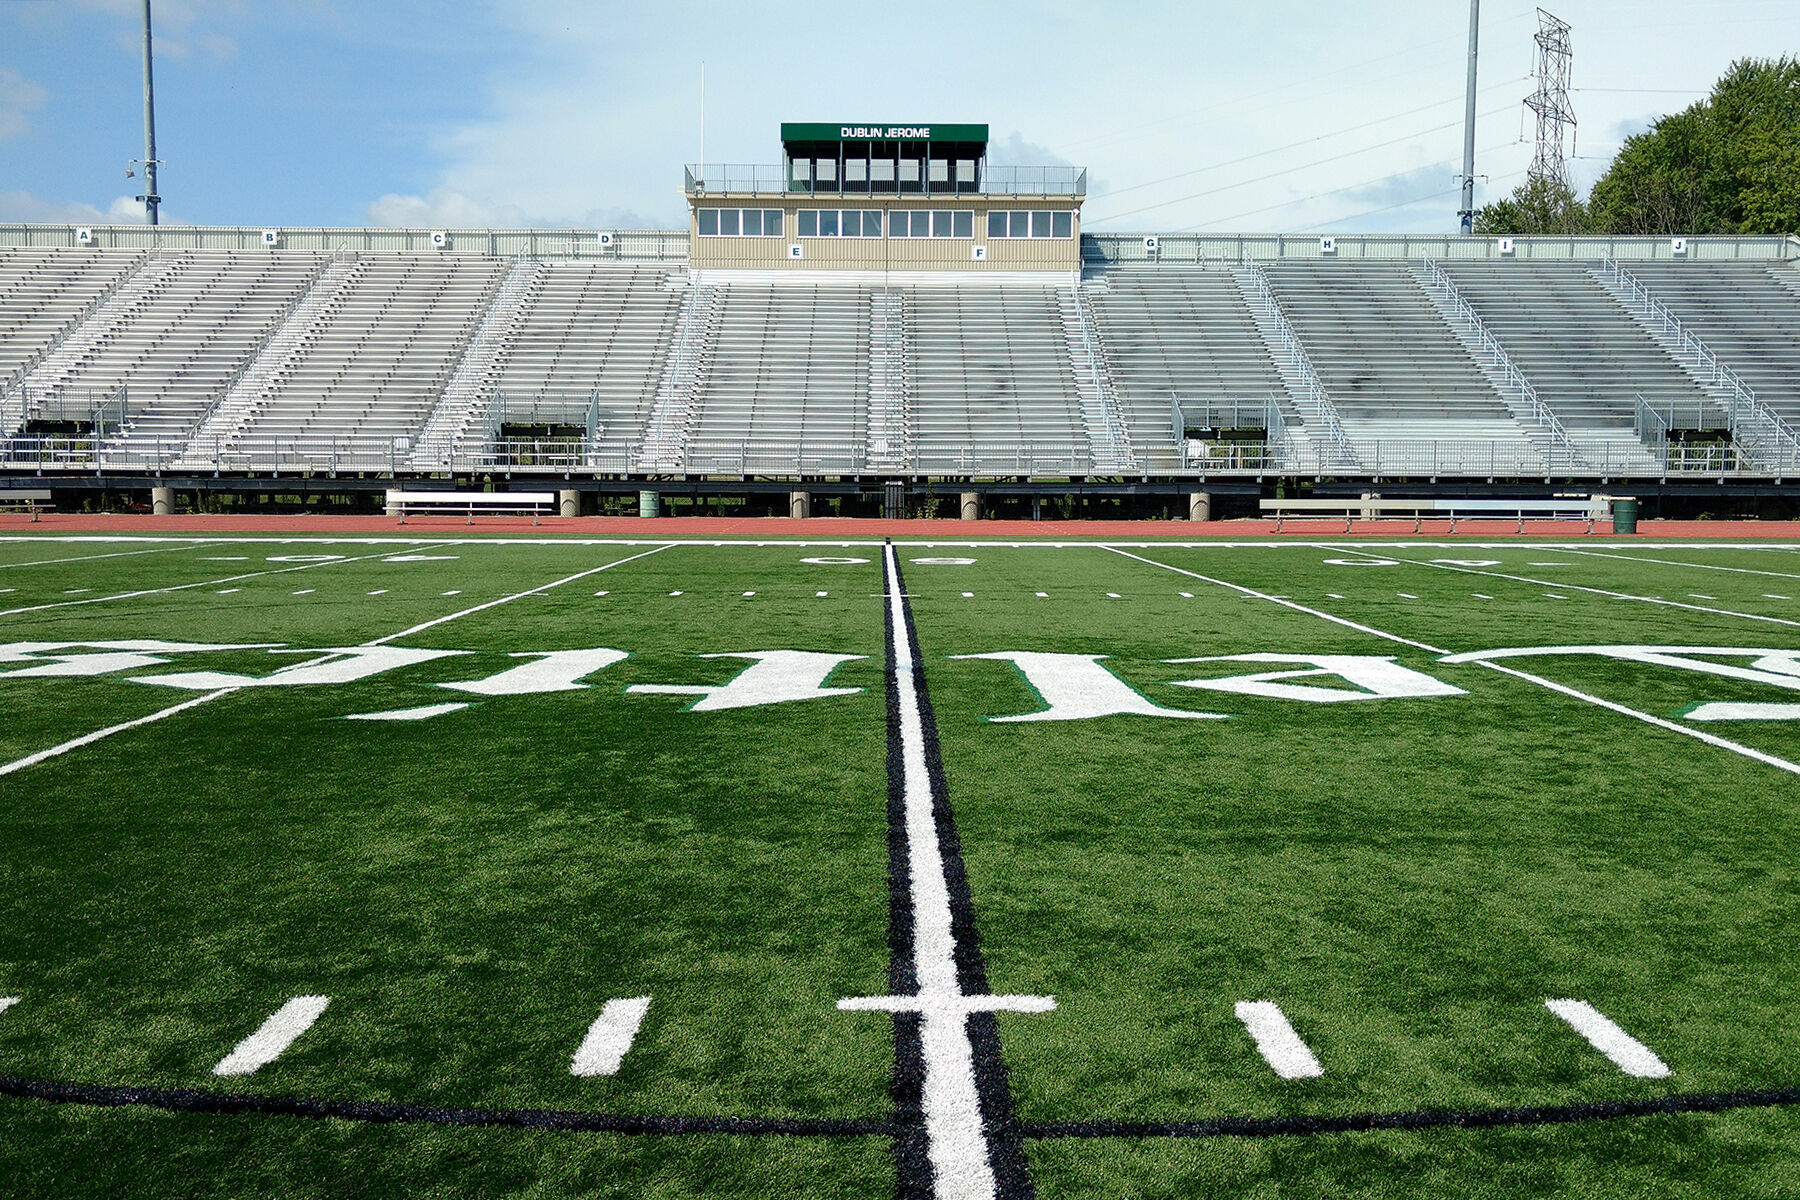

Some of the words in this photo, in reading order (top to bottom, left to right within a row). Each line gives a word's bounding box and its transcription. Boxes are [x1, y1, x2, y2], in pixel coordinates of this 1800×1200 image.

[840, 127, 882, 138] DUBLIN
[884, 127, 930, 138] JEROME
[80, 231, 88, 239] A
[266, 233, 274, 242] B
[433, 235, 442, 243] C
[602, 235, 609, 243] D
[1146, 239, 1155, 248] G
[1323, 240, 1331, 249] H
[1675, 241, 1682, 250] J
[793, 247, 801, 256] E
[976, 248, 983, 257] F
